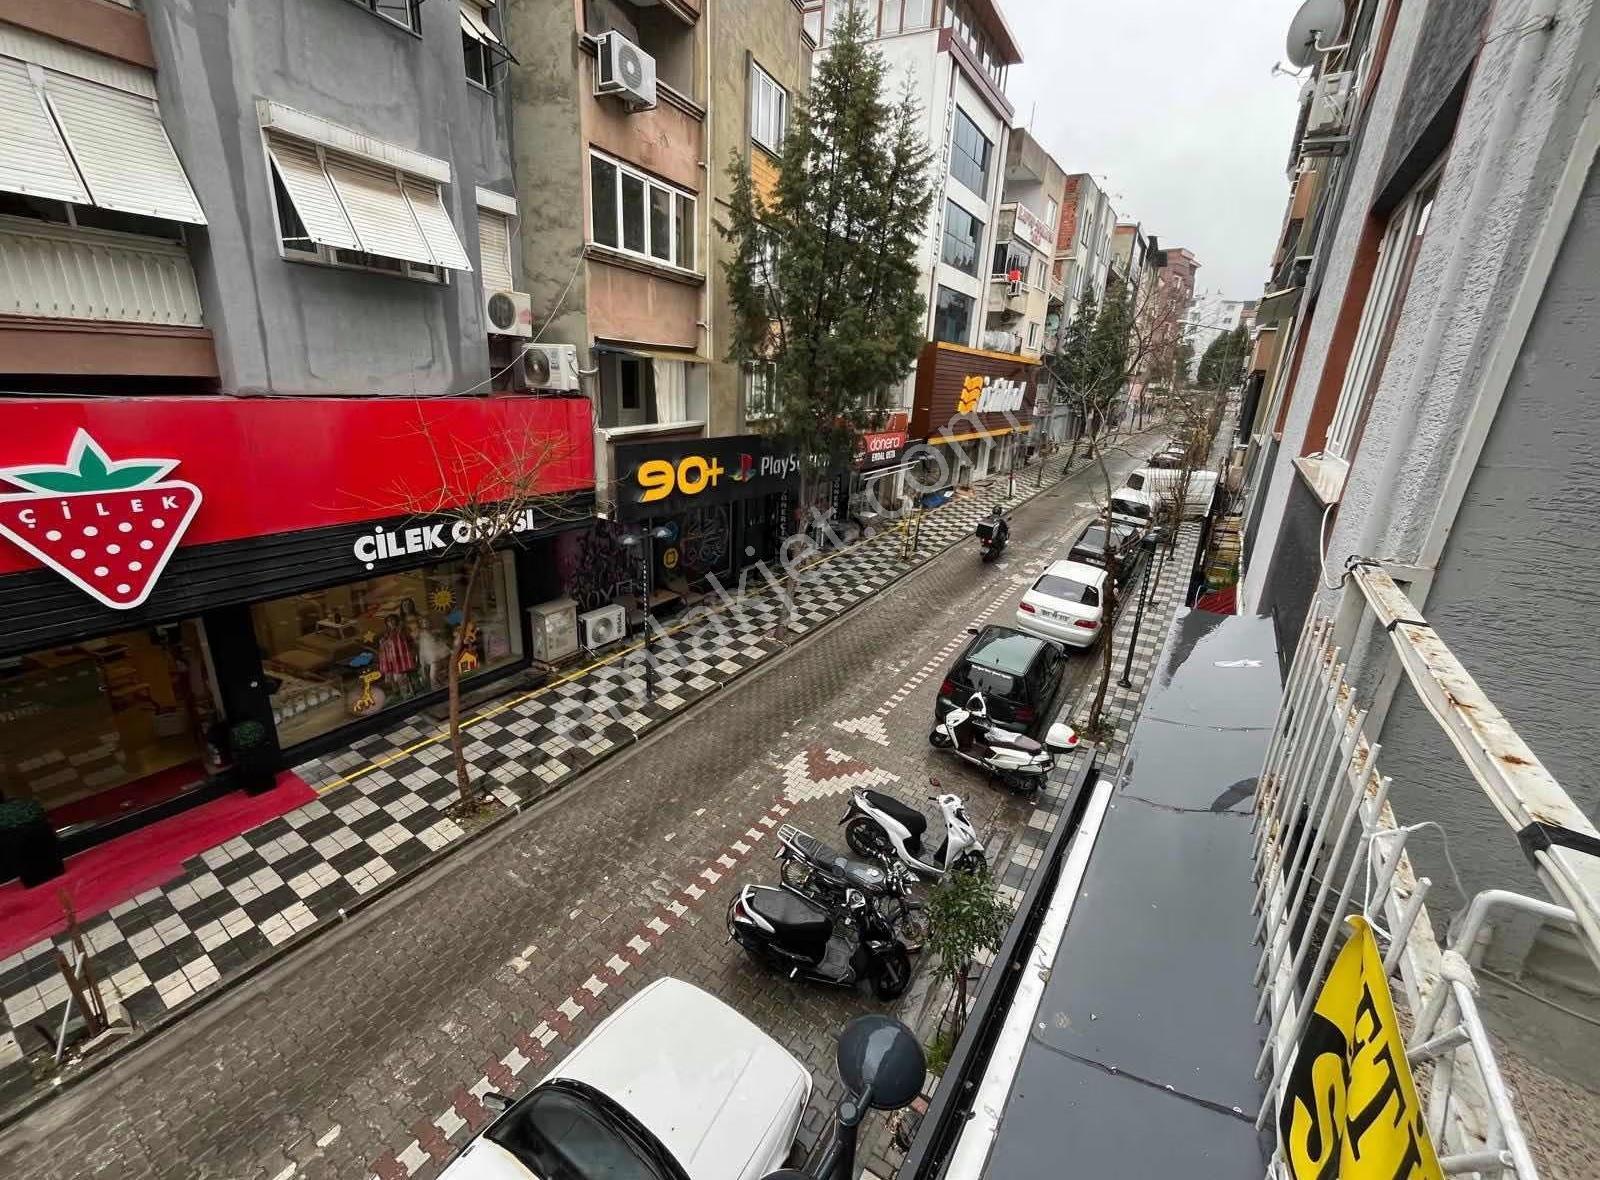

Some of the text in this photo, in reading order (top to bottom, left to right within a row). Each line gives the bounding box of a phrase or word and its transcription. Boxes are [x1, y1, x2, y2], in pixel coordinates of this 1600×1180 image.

[636, 456, 725, 503] 90+
[18, 495, 181, 529] ÇİLEK
[353, 515, 447, 571] ÇİLEK
